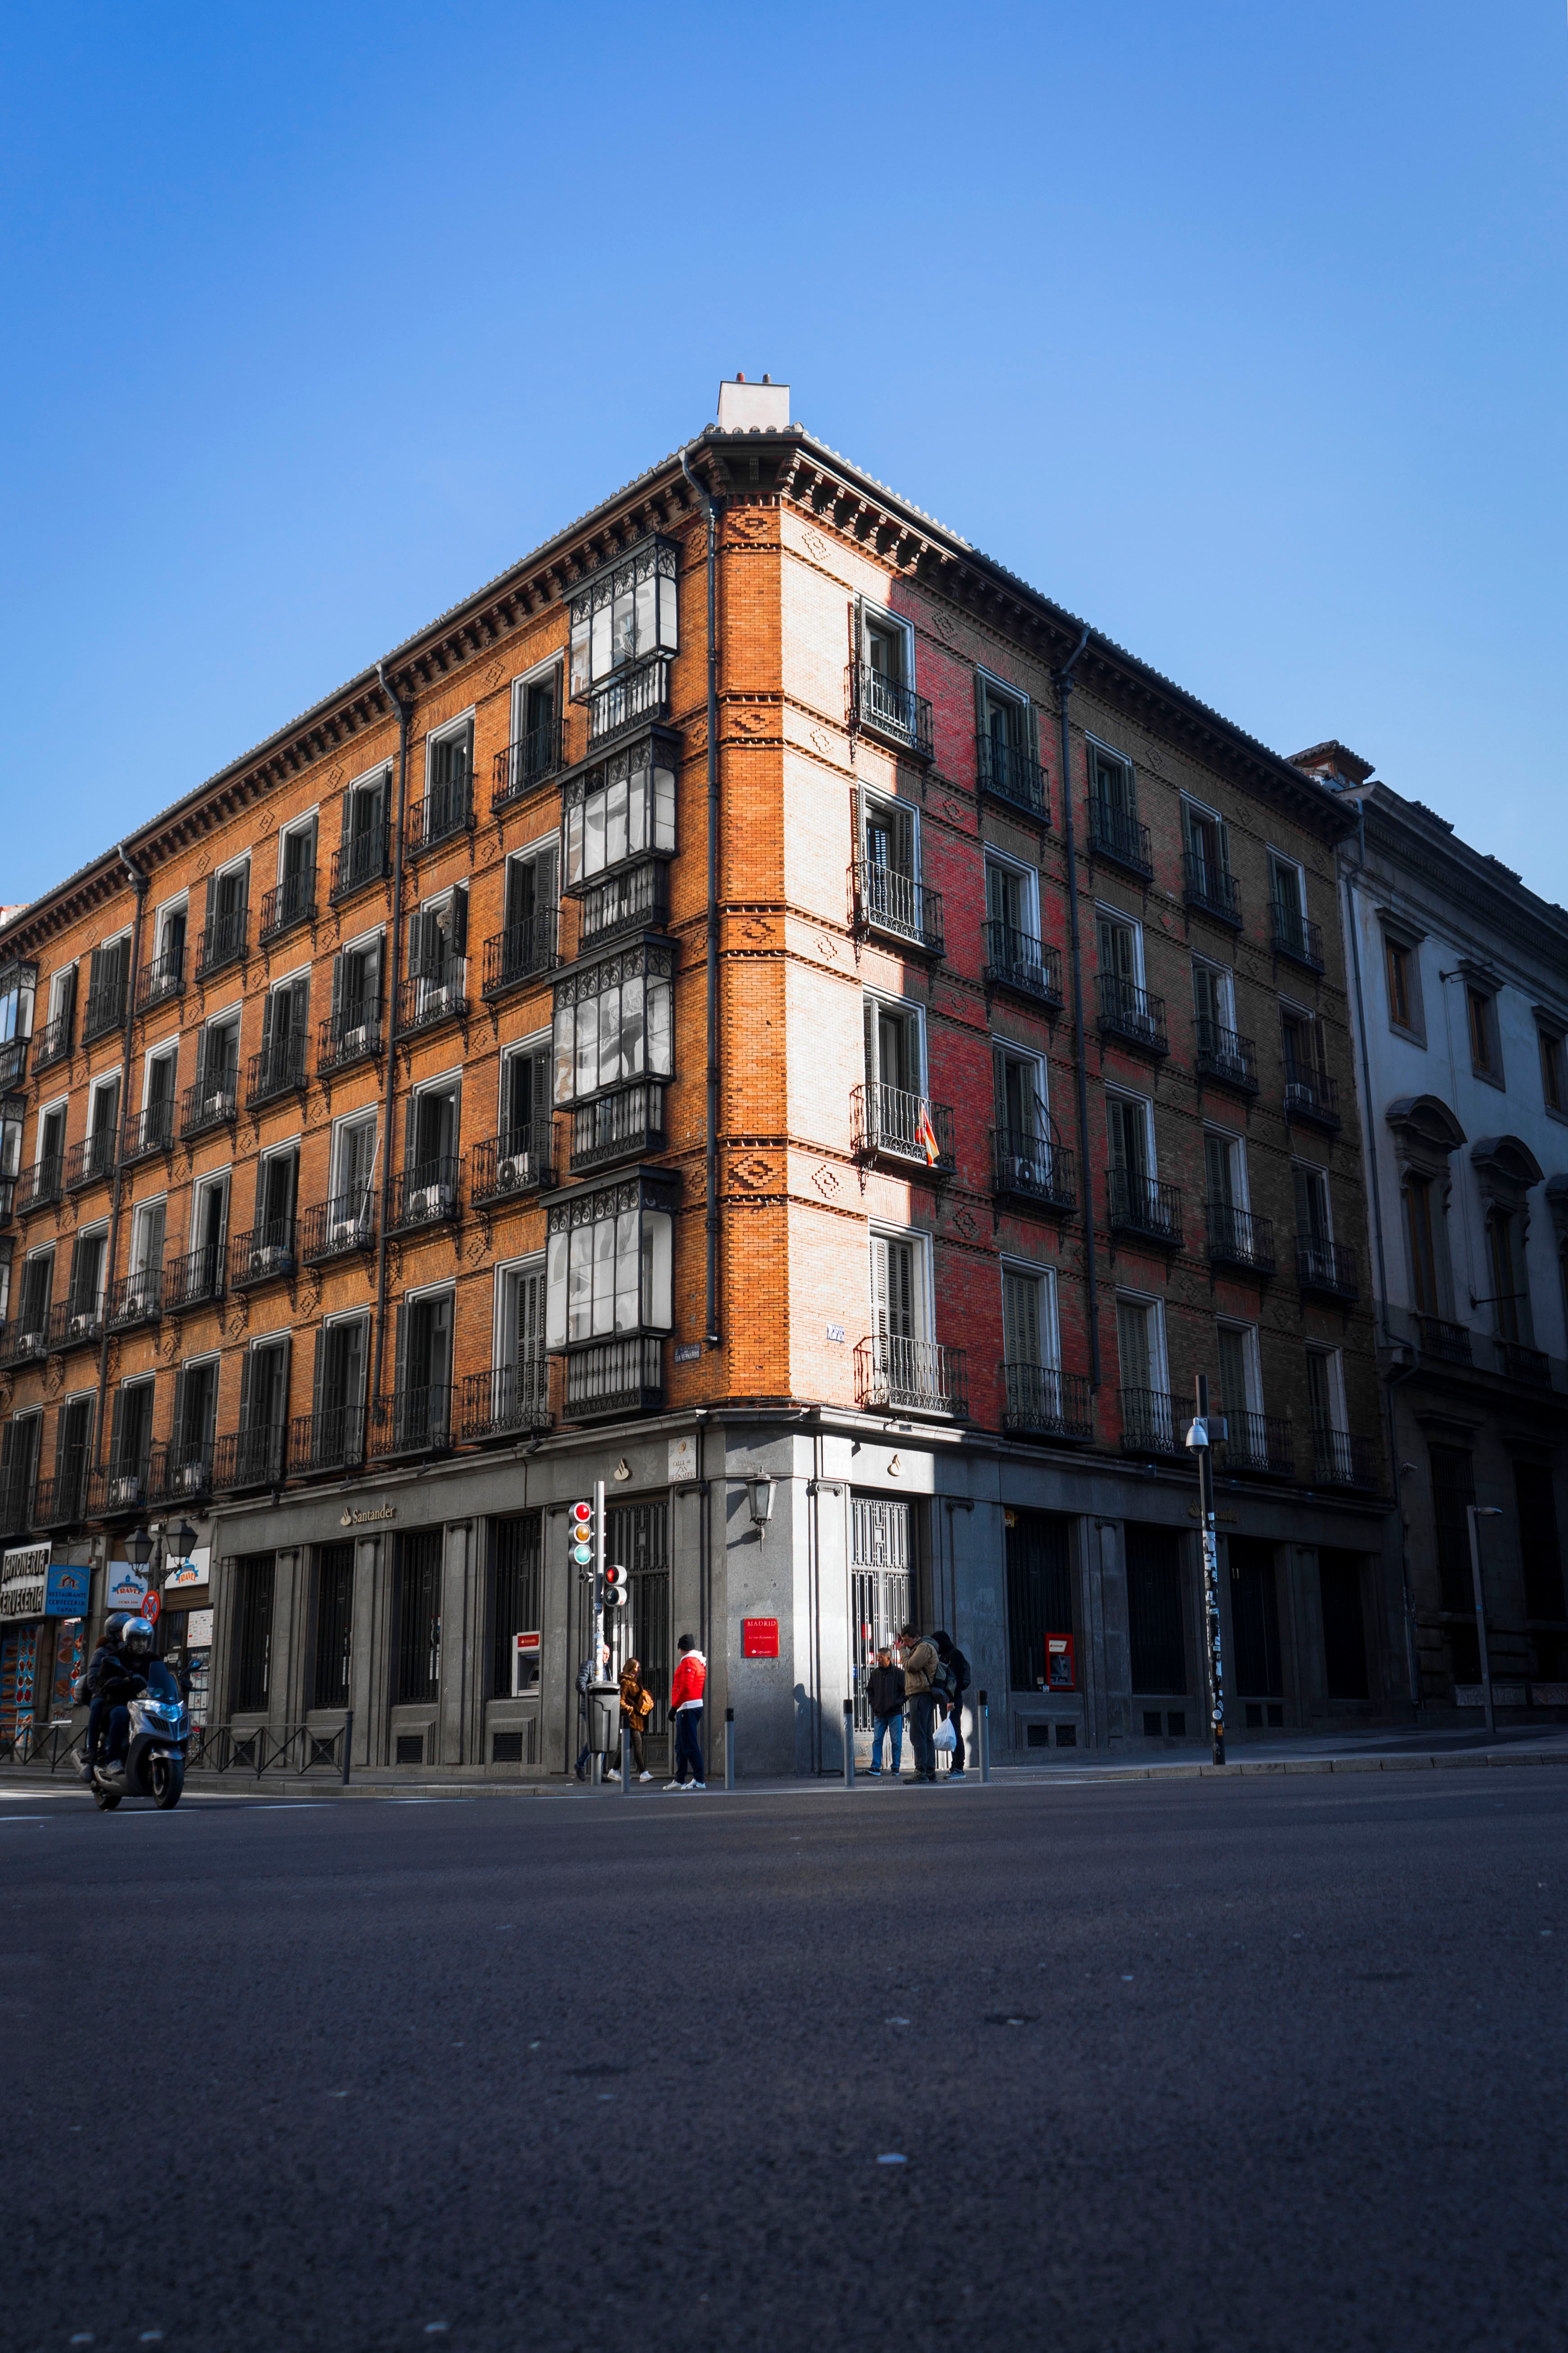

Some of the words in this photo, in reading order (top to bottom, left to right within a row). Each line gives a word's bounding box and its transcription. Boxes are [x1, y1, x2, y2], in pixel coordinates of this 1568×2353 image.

[681, 1351, 699, 1361] BERNARDO
[670, 1472, 695, 1481] BERNARDO
[353, 1503, 394, 1523] Santander
[2, 1549, 45, 1582] JAMONERIA
[178, 1572, 196, 1584] TRAVEL
